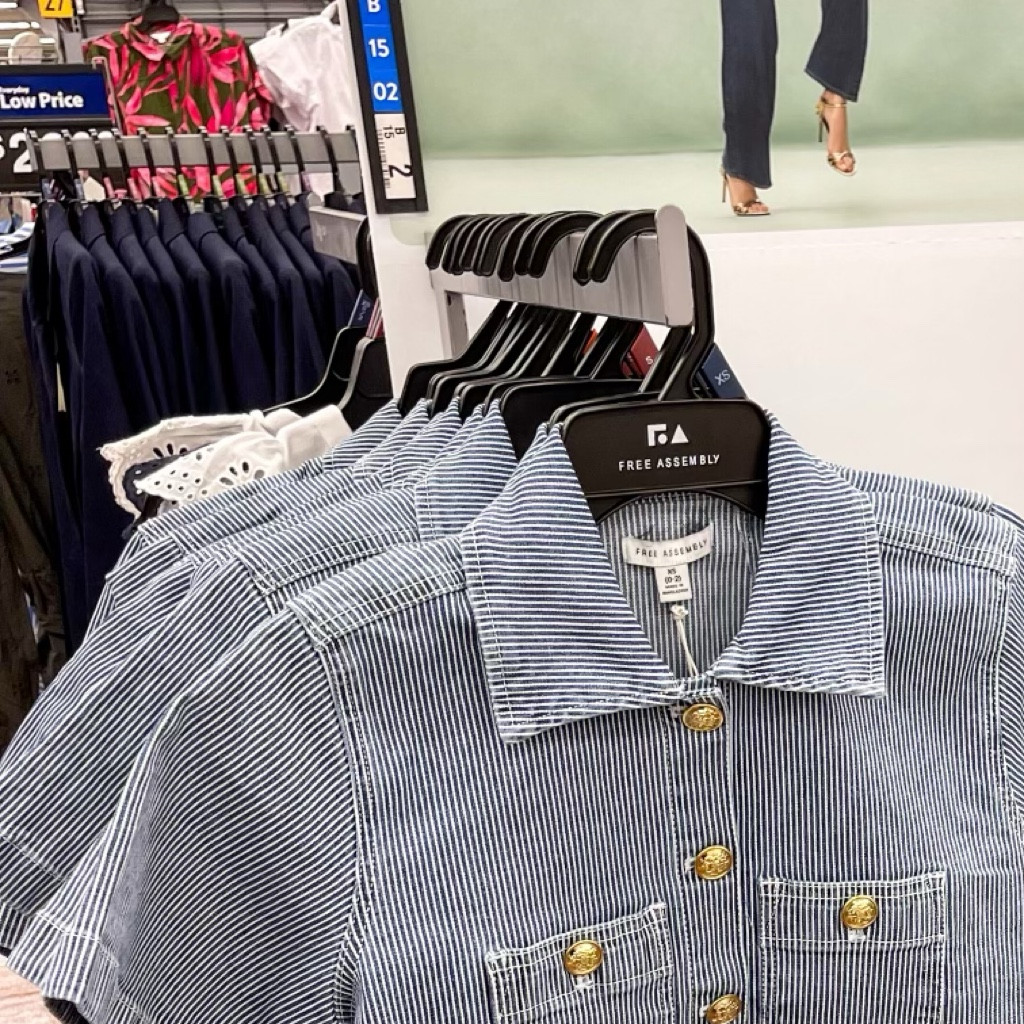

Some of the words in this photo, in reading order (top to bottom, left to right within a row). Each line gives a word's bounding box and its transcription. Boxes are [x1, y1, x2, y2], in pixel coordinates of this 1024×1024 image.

[366, 0, 381, 13] B
[368, 38, 390, 58] 15
[0, 94, 37, 109] Low
[38, 91, 84, 108] Price
[373, 82, 399, 101] 02
[388, 164, 413, 178] 2
[714, 369, 731, 386] XS
[618, 458, 653, 472] FREE
[656, 453, 720, 469] ASSEMBLY
[636, 547, 658, 558] FREE
[663, 538, 708, 558] ASSEMBLY
